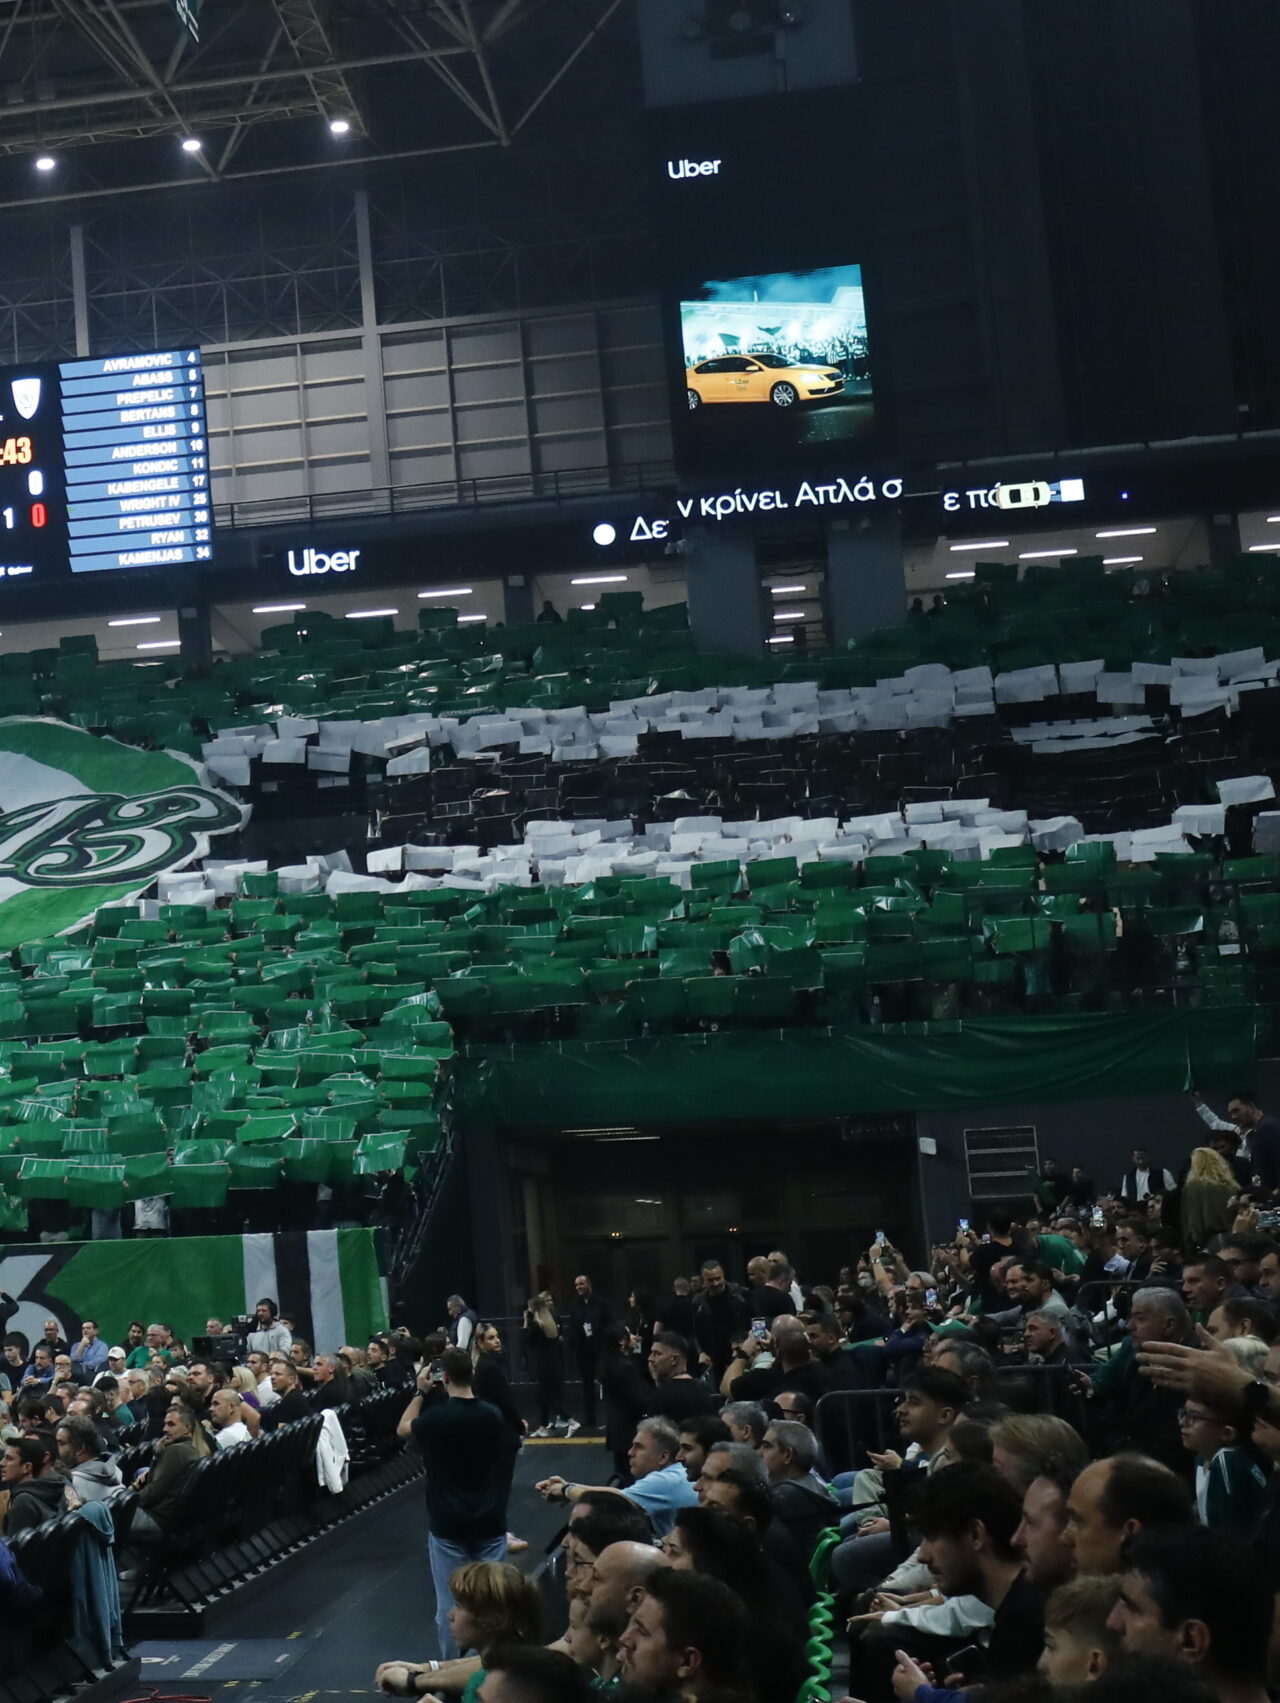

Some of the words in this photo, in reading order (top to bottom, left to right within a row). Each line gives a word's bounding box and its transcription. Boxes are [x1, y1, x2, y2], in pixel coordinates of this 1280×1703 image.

[667, 159, 722, 179] Uber
[103, 353, 172, 372] AVRAMOVIC
[187, 351, 196, 363] 4
[132, 371, 174, 386] ABASS
[116, 389, 174, 405] PREPELIC
[189, 386, 197, 398] 7
[120, 406, 175, 423] BERTANS
[190, 404, 198, 416] 8
[143, 423, 176, 438] ELLIS
[191, 422, 199, 433] 9
[111, 441, 177, 459] ANDERSON
[190, 439, 203, 451] 10
[133, 459, 178, 475] KONDIC
[191, 457, 204, 469] 11
[28, 470, 43, 496] 0
[108, 477, 179, 495] KABENGELE
[192, 474, 205, 487] 17
[120, 496, 166, 512] WRIGHT
[168, 494, 180, 507] IV
[193, 492, 207, 505] 25
[700, 488, 788, 520] κρίνει.
[794, 476, 876, 507] Απλά
[3, 507, 14, 529] 1
[31, 503, 45, 528] 0
[119, 513, 180, 529] PETRUSEV
[195, 510, 207, 523] 30
[151, 530, 184, 545] RYAN
[195, 528, 209, 541] 32
[119, 548, 183, 565] KAMENJAS
[196, 546, 210, 559] 34
[287, 548, 360, 576] Uber
